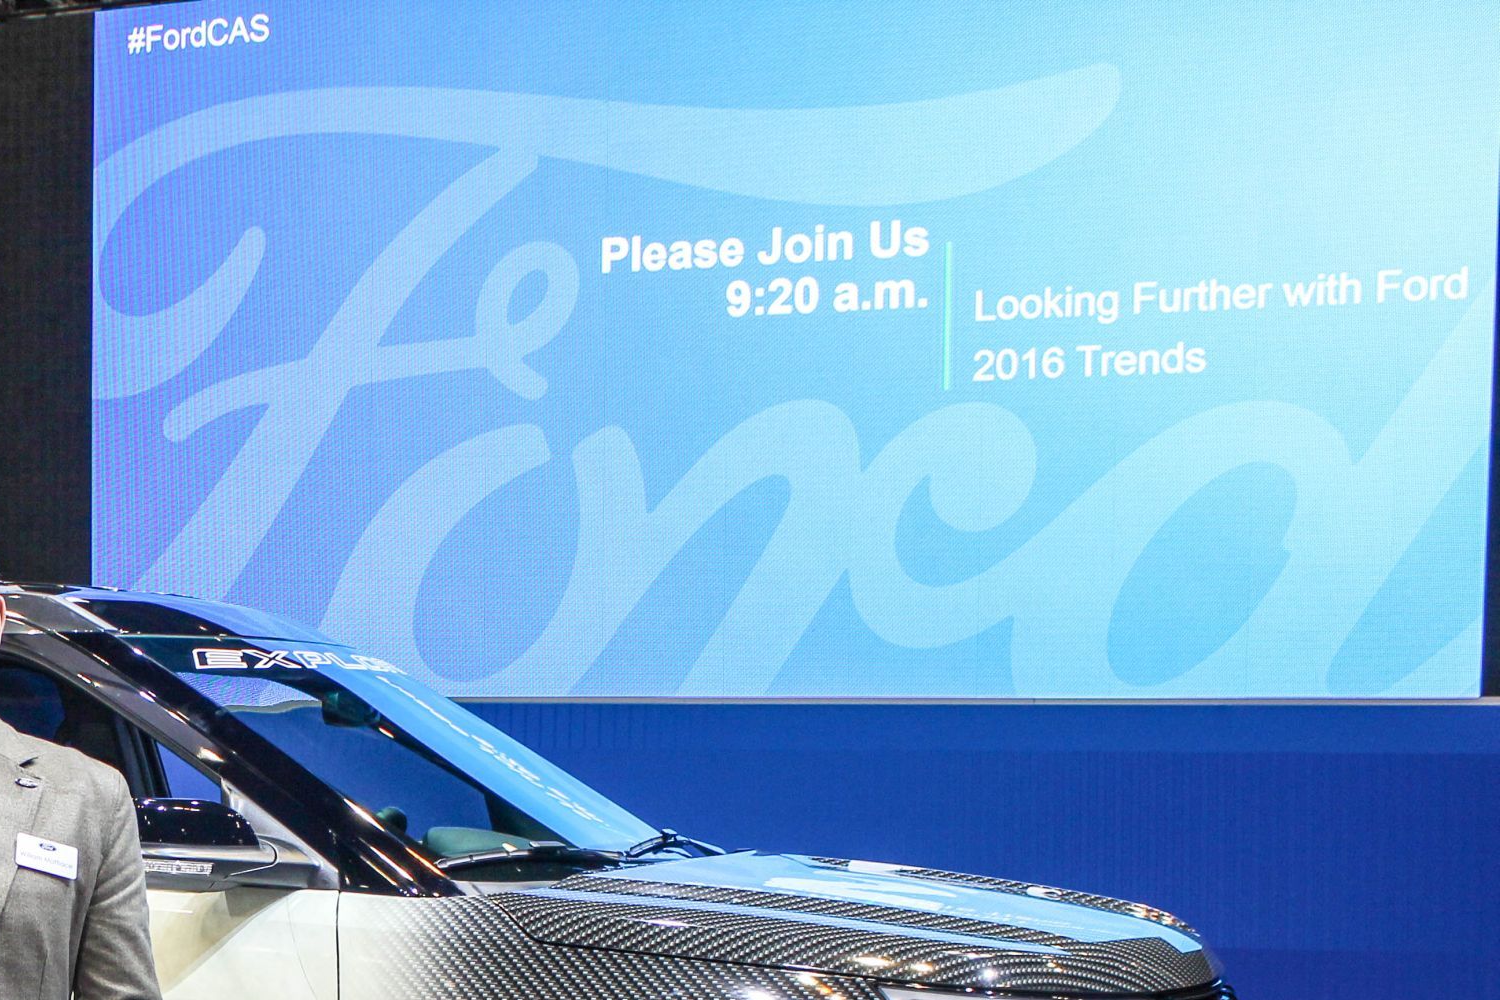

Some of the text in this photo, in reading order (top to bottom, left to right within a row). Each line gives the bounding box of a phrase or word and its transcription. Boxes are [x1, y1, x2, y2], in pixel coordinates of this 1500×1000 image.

[127, 13, 270, 54] #FordCAS
[601, 219, 930, 274] Please Join Us
[726, 276, 928, 318] 9:20 a.m.
[974, 266, 1470, 325] Looking Further with Ford
[972, 341, 1206, 382] 2016 Trends
